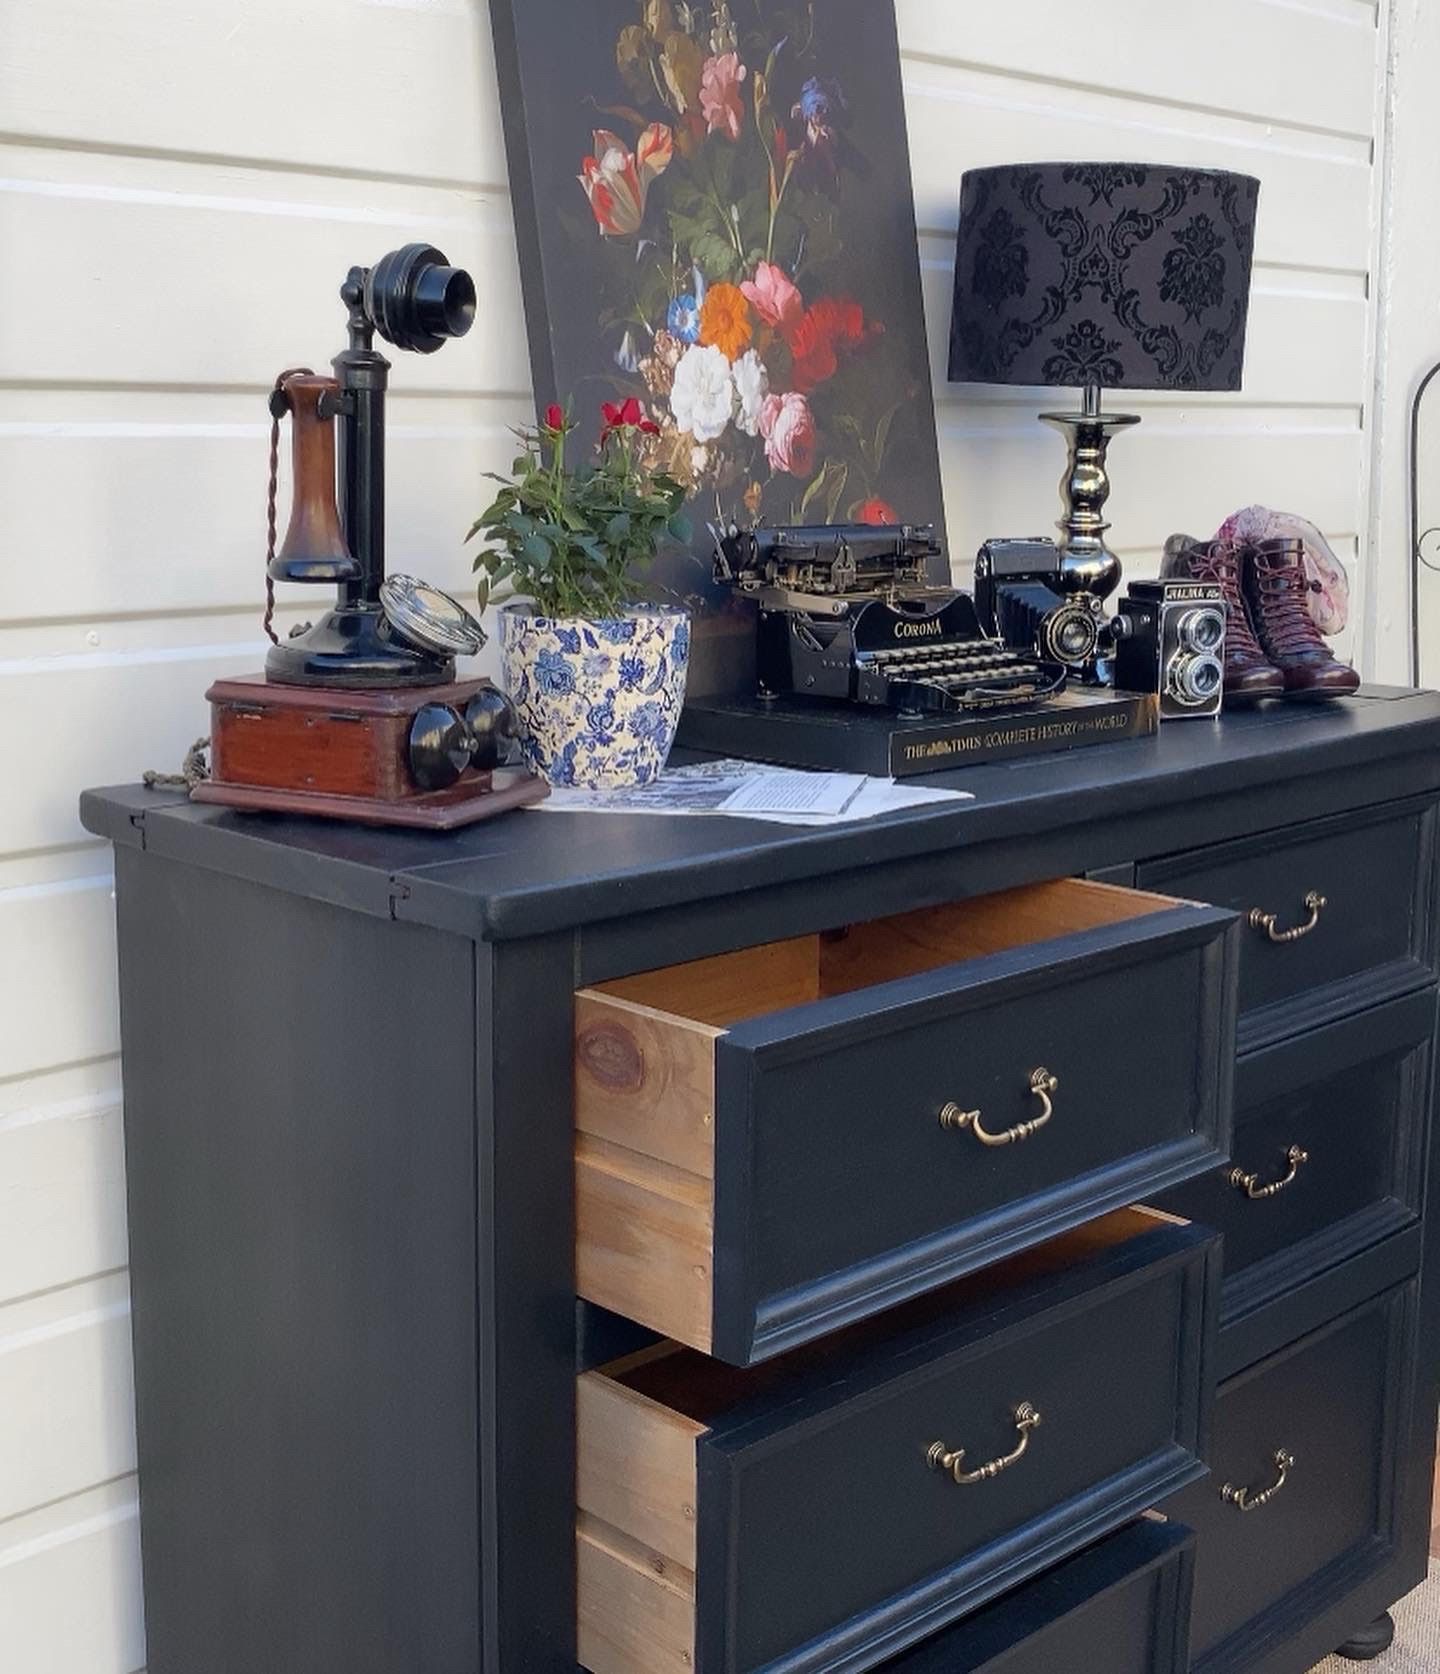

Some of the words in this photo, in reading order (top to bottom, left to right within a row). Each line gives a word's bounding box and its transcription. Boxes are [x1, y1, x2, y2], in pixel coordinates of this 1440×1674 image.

[893, 617, 943, 639] CORONA
[904, 744, 927, 760] THE
[951, 736, 982, 753] TIMES
[985, 728, 1036, 748] COMPLETE
[1038, 721, 1077, 741] HISTORY
